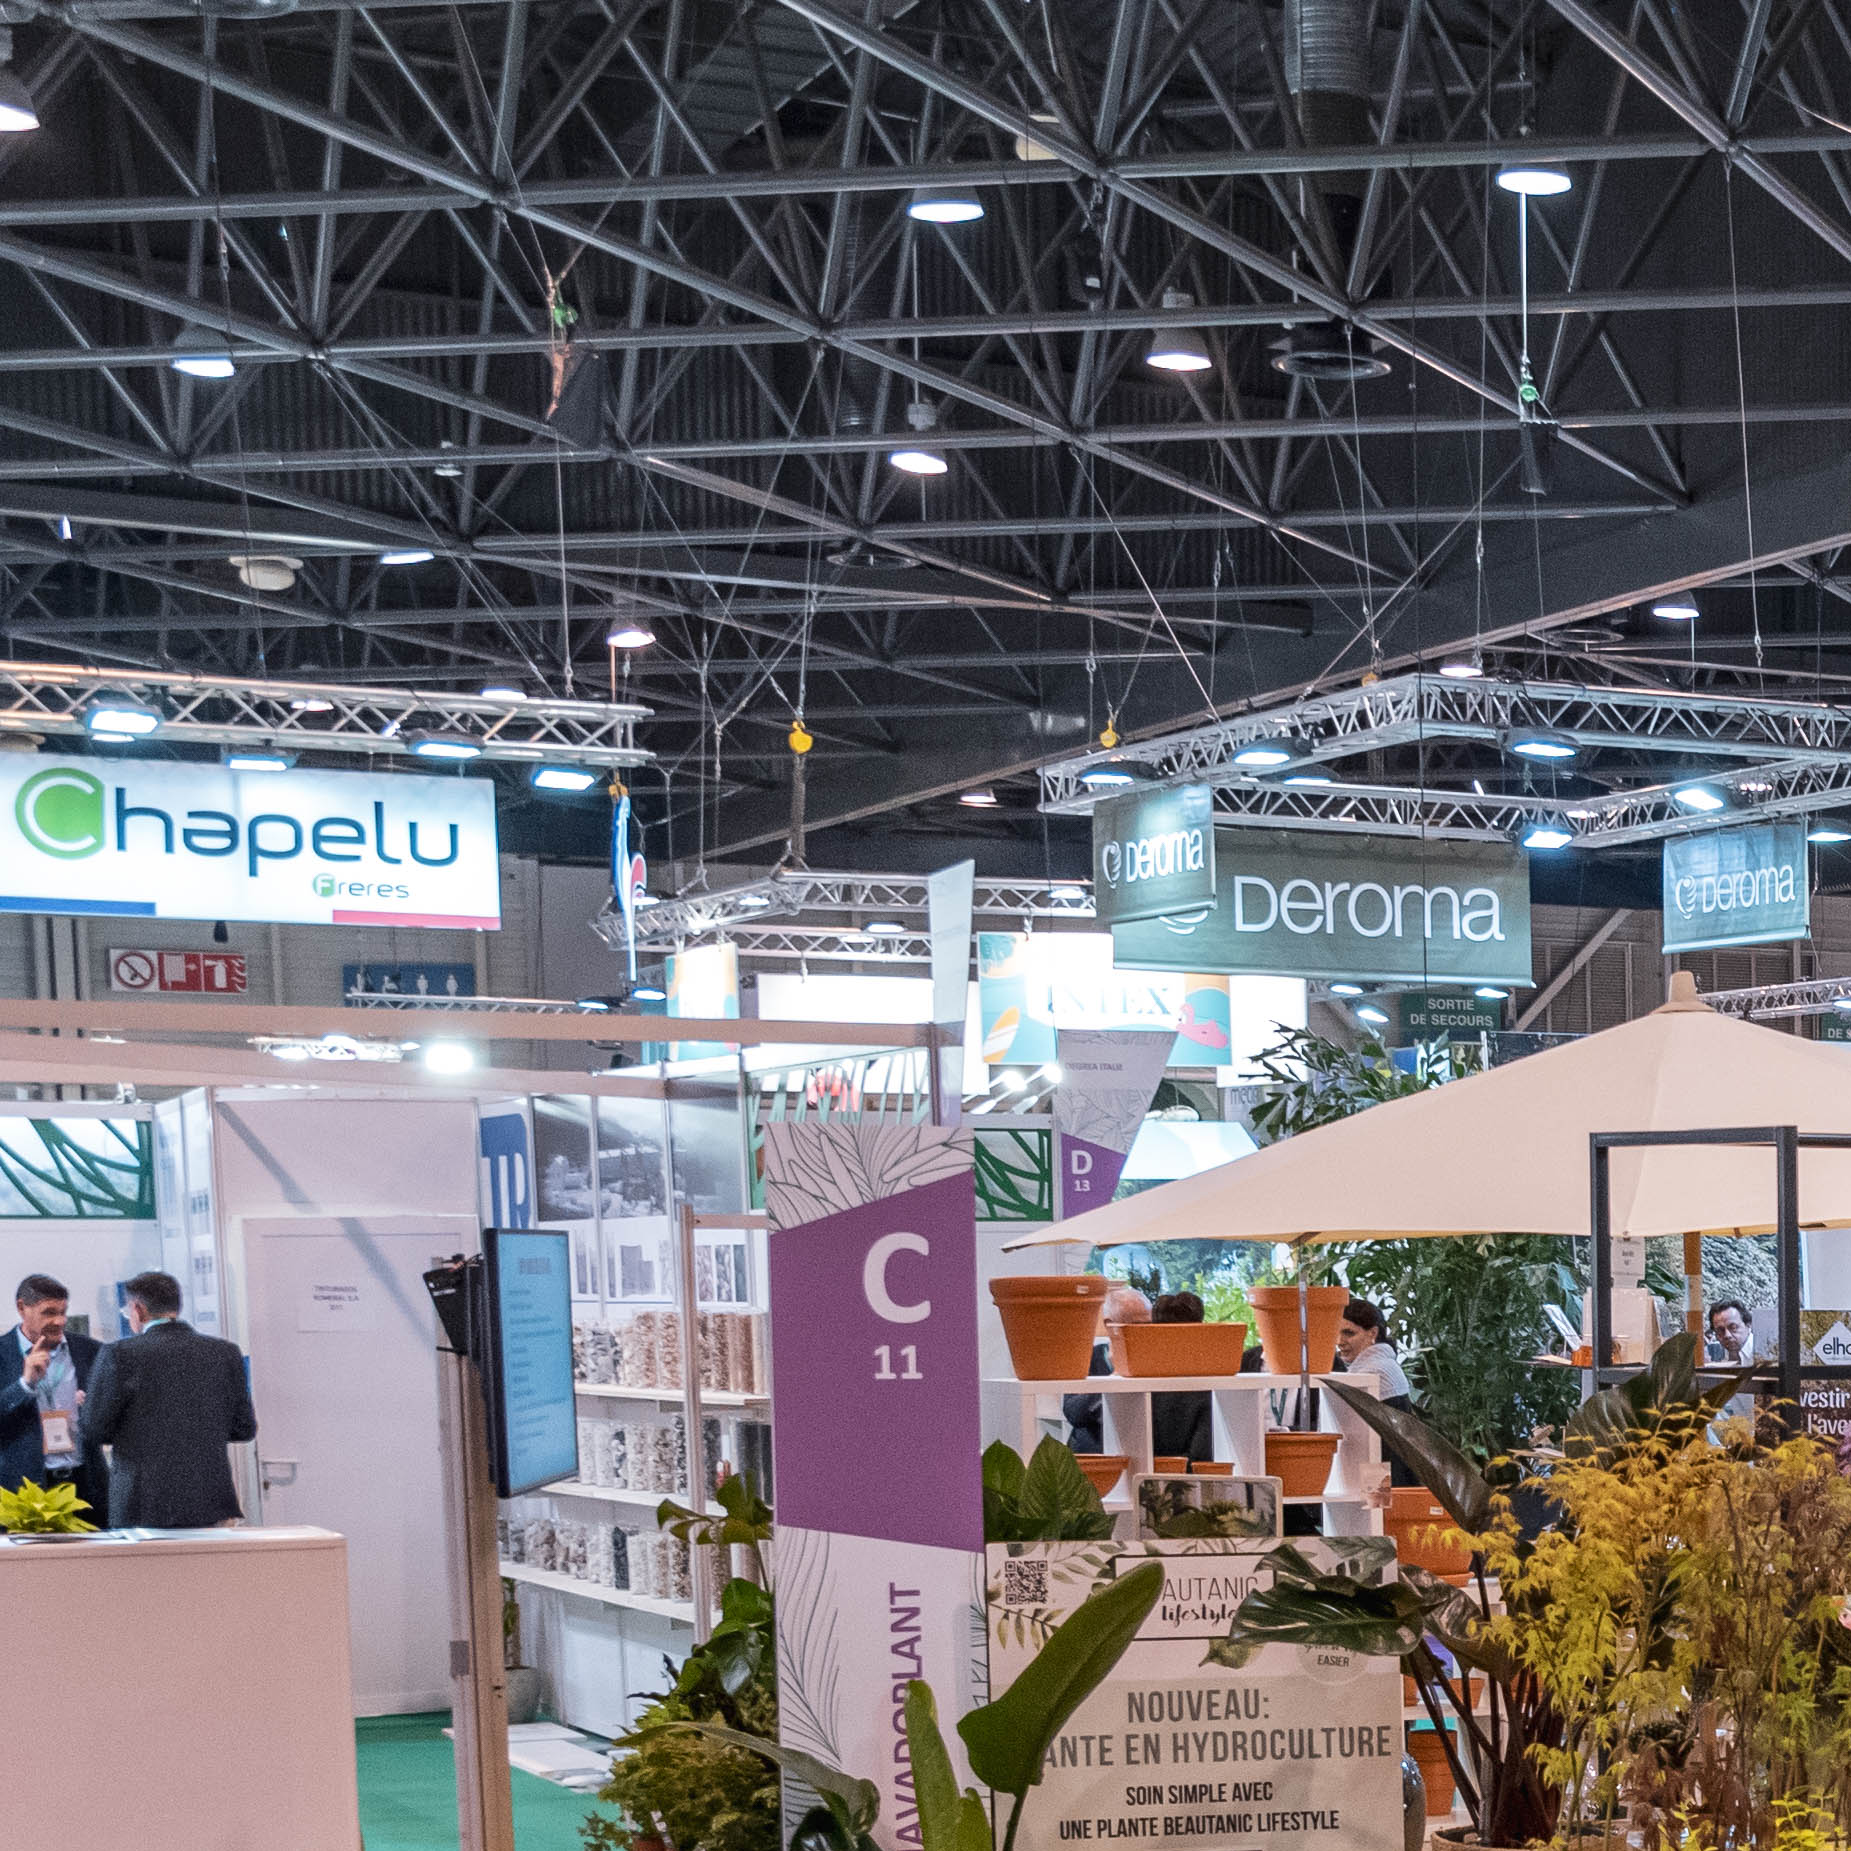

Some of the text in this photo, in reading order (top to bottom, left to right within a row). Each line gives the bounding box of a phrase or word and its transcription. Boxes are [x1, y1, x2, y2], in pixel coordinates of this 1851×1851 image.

[14, 767, 461, 876] Chapelu
[1126, 828, 1205, 884] Deroma
[312, 873, 410, 900] Freres
[1702, 863, 1796, 915] Deroma
[1234, 875, 1506, 942] Deroma
[1427, 998, 1475, 1011] SORTIE
[1410, 1013, 1494, 1027] DE SECOURS
[1071, 1150, 1093, 1175] D
[1074, 1180, 1091, 1192] 13
[863, 1231, 932, 1325] C
[873, 1344, 924, 1380] 11
[1800, 1387, 1850, 1409] vestir
[1807, 1413, 1851, 1435] l'ave
[1162, 1576, 1258, 1602] AUTANIC
[1317, 1654, 1350, 1668] EASIER
[1128, 1689, 1270, 1723] NOUVEAU:
[1046, 1725, 1392, 1768] ANTE EN HYDROCULTURE
[1126, 1781, 1273, 1806] SOIN SIMPLE AVEC
[1060, 1810, 1340, 1840] UNE PLANTE BEAUTANIC LIFESTYLE
